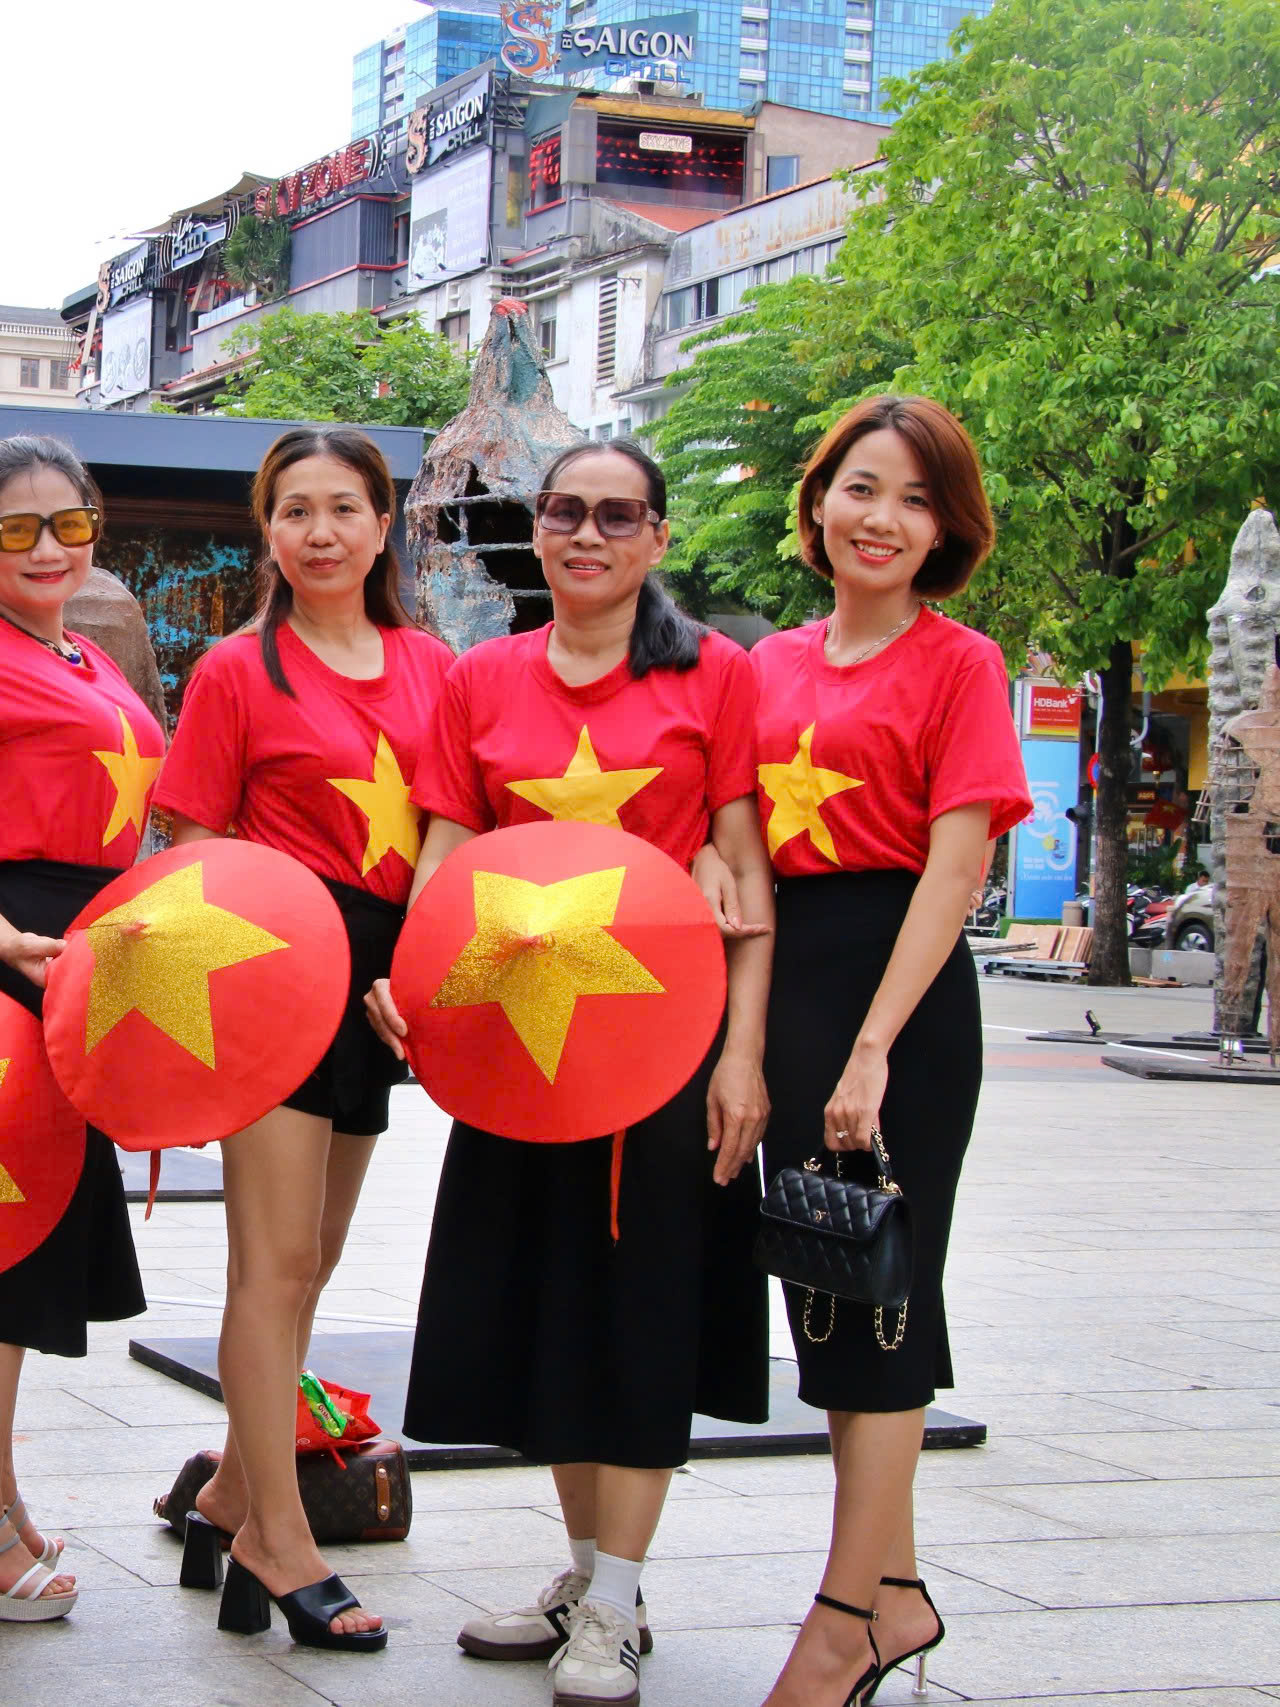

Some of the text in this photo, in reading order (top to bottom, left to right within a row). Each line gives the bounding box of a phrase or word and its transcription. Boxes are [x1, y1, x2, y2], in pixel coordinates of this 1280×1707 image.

[562, 26, 694, 61] BI SAIGON
[605, 59, 691, 84] CHILL
[436, 92, 484, 137] SAIGON
[447, 122, 482, 151] CHILL
[172, 231, 207, 260] CHILL
[115, 257, 145, 287] SAIGON
[1033, 697, 1069, 709] HDBank
